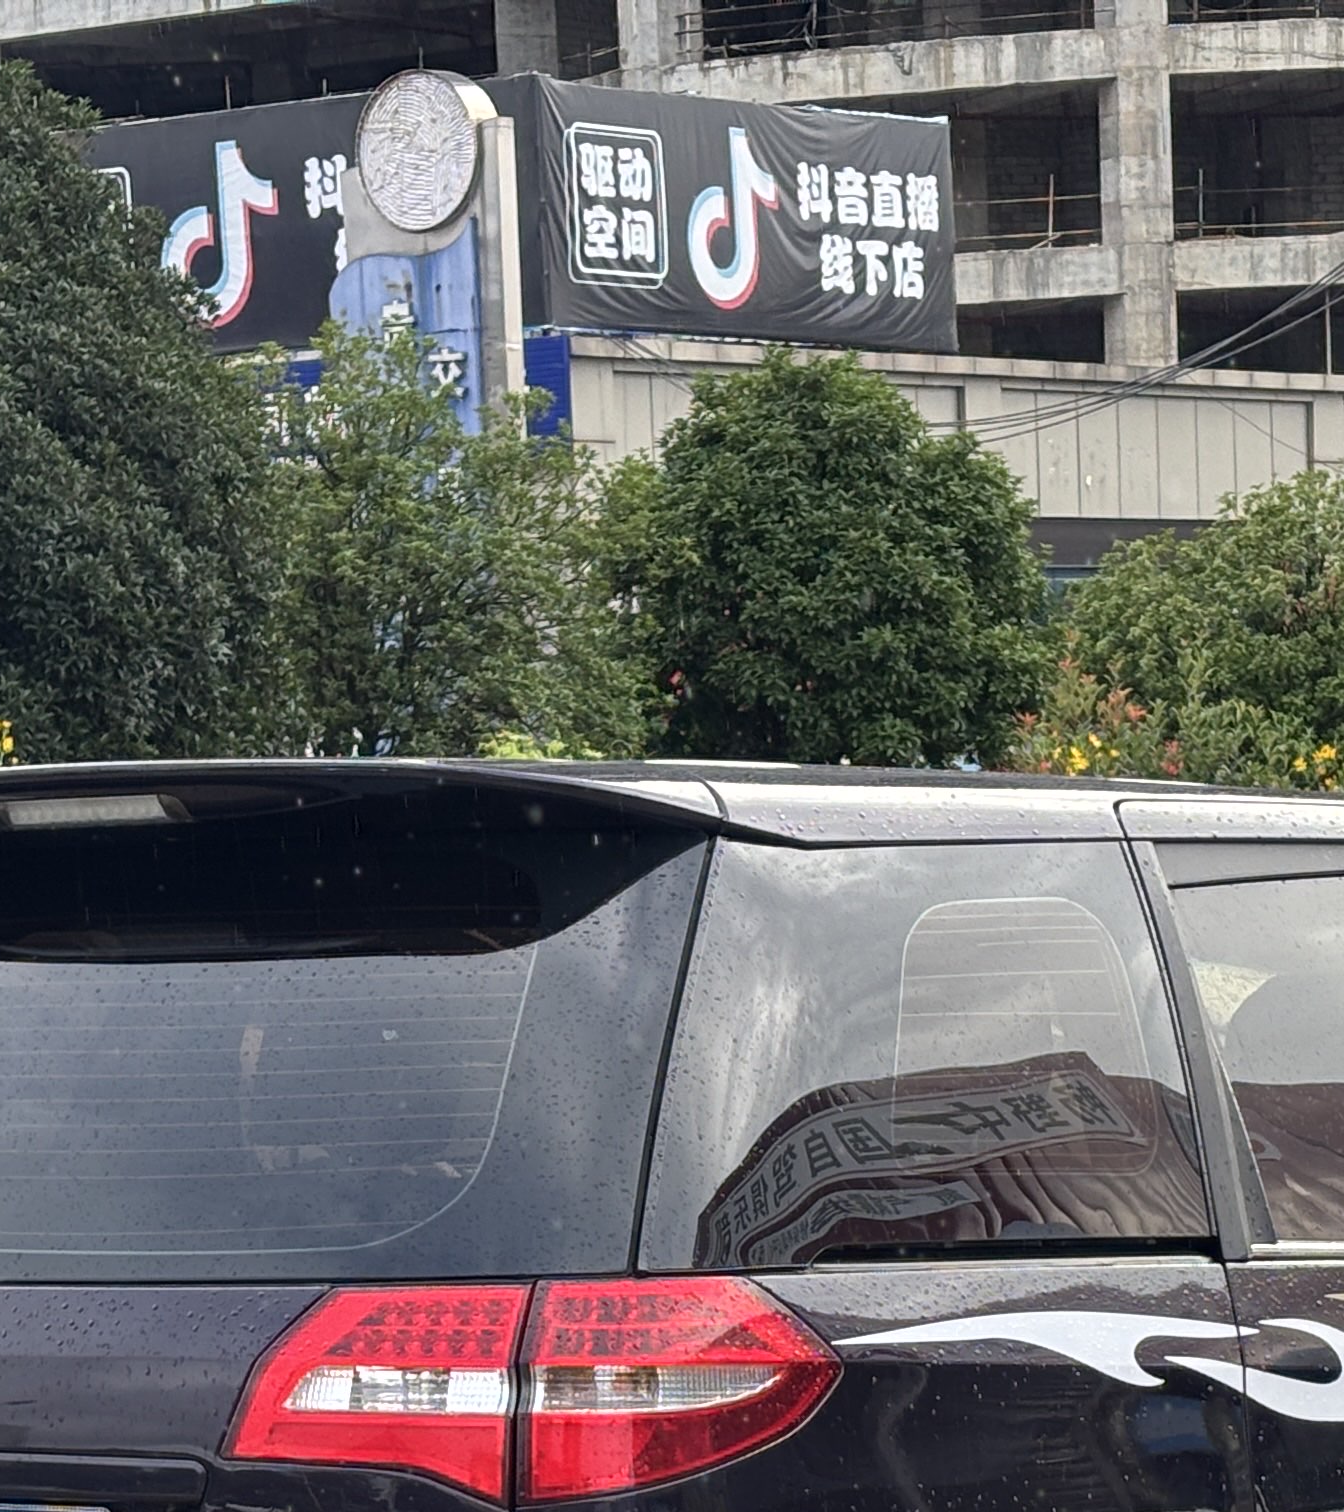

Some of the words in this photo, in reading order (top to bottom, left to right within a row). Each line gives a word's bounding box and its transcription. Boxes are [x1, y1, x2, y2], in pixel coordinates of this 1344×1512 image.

[580, 142, 652, 201] 驱动
[797, 161, 940, 232] 抖音直播
[583, 205, 655, 262] 空间
[820, 233, 925, 299] 线下店
